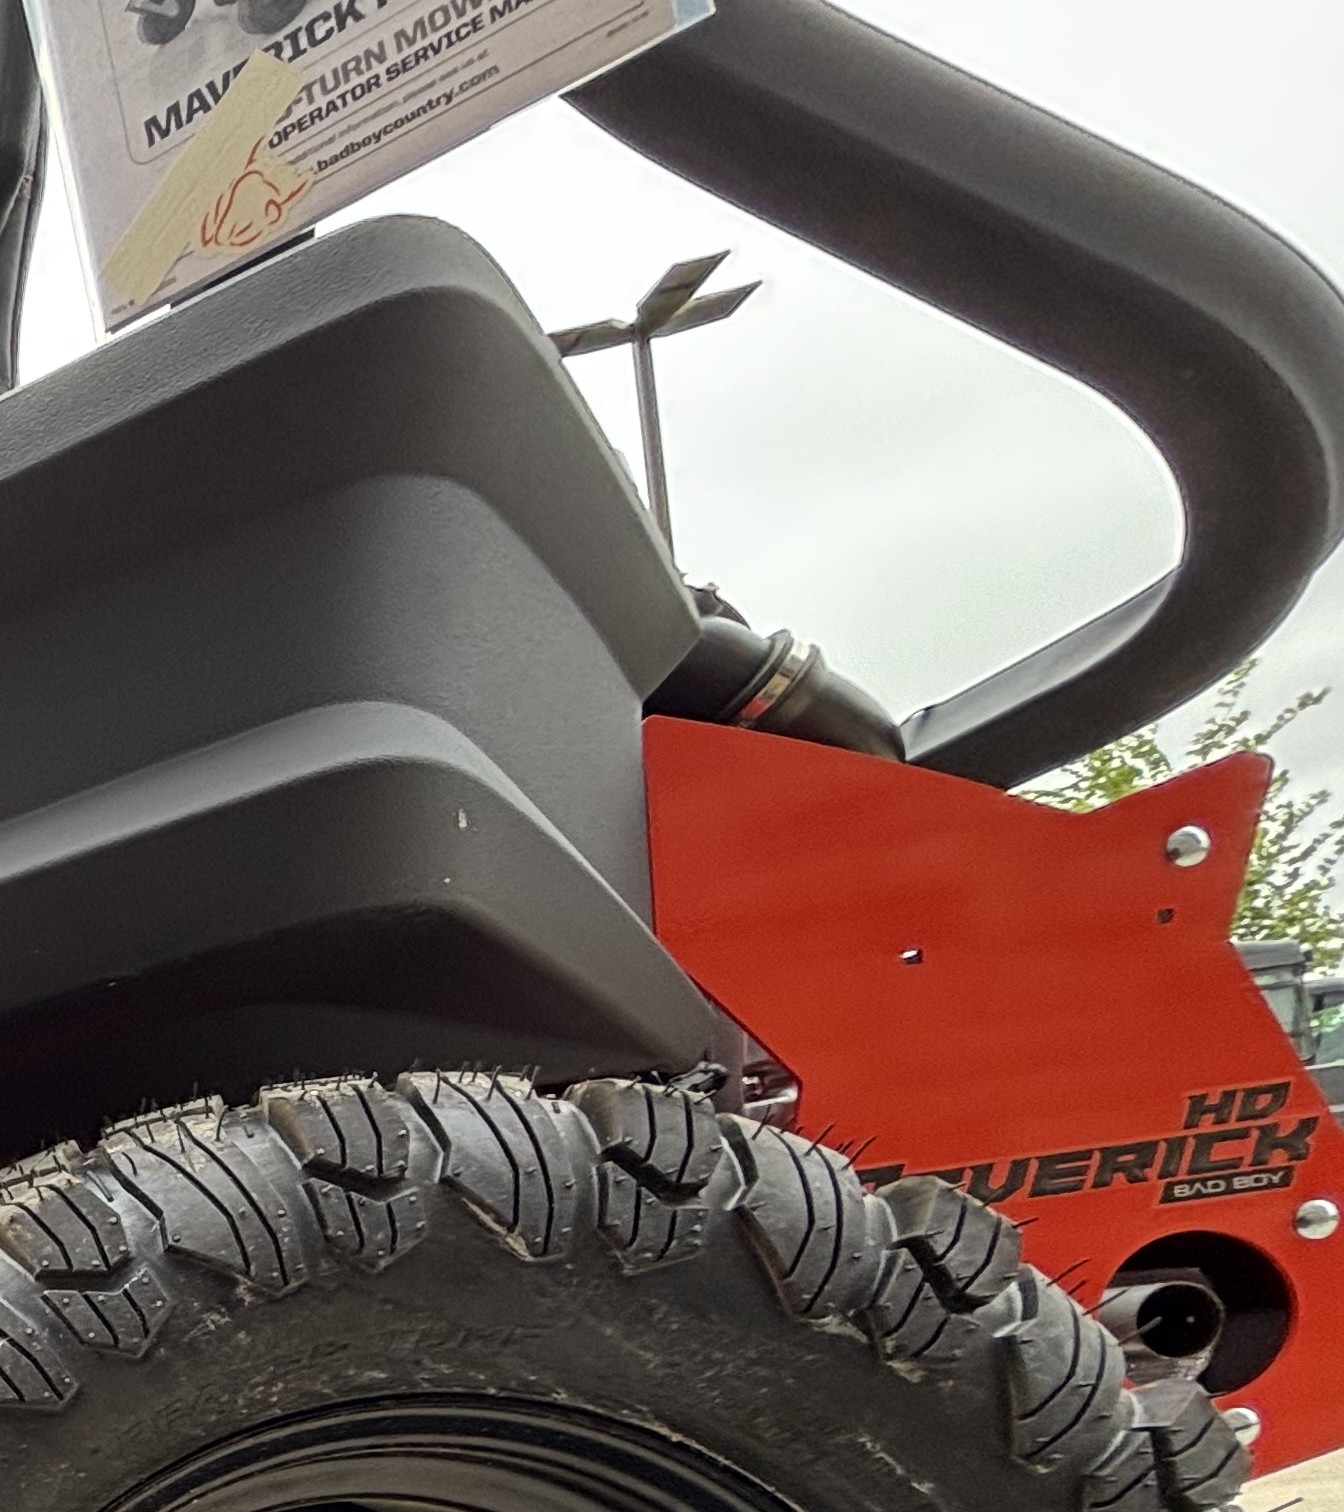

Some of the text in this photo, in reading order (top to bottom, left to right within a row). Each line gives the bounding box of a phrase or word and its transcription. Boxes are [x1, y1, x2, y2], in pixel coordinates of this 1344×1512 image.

[268, 73, 382, 149] OPERATOR
[385, 12, 485, 83] SERVICE
[1184, 1082, 1292, 1130] HD
[855, 1117, 1319, 1203] VERICK
[1173, 1170, 1285, 1198] BAD BOY
